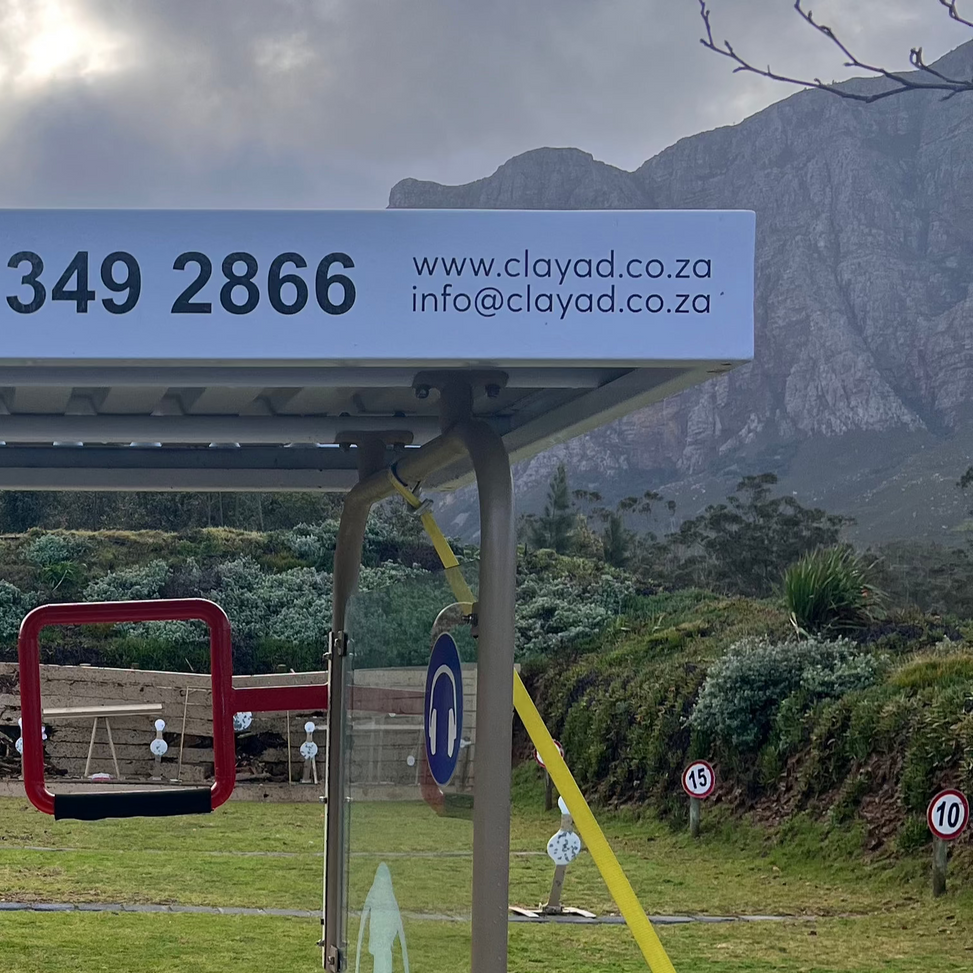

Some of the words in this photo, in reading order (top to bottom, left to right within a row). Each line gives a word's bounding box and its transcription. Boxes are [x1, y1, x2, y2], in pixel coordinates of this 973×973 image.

[6, 250, 141, 314] 349
[171, 251, 357, 314] 2866
[412, 249, 713, 285] www.clayad.co.za
[411, 285, 712, 319] info@clayad.co.za
[688, 768, 708, 789] 15
[935, 801, 960, 829] 10
